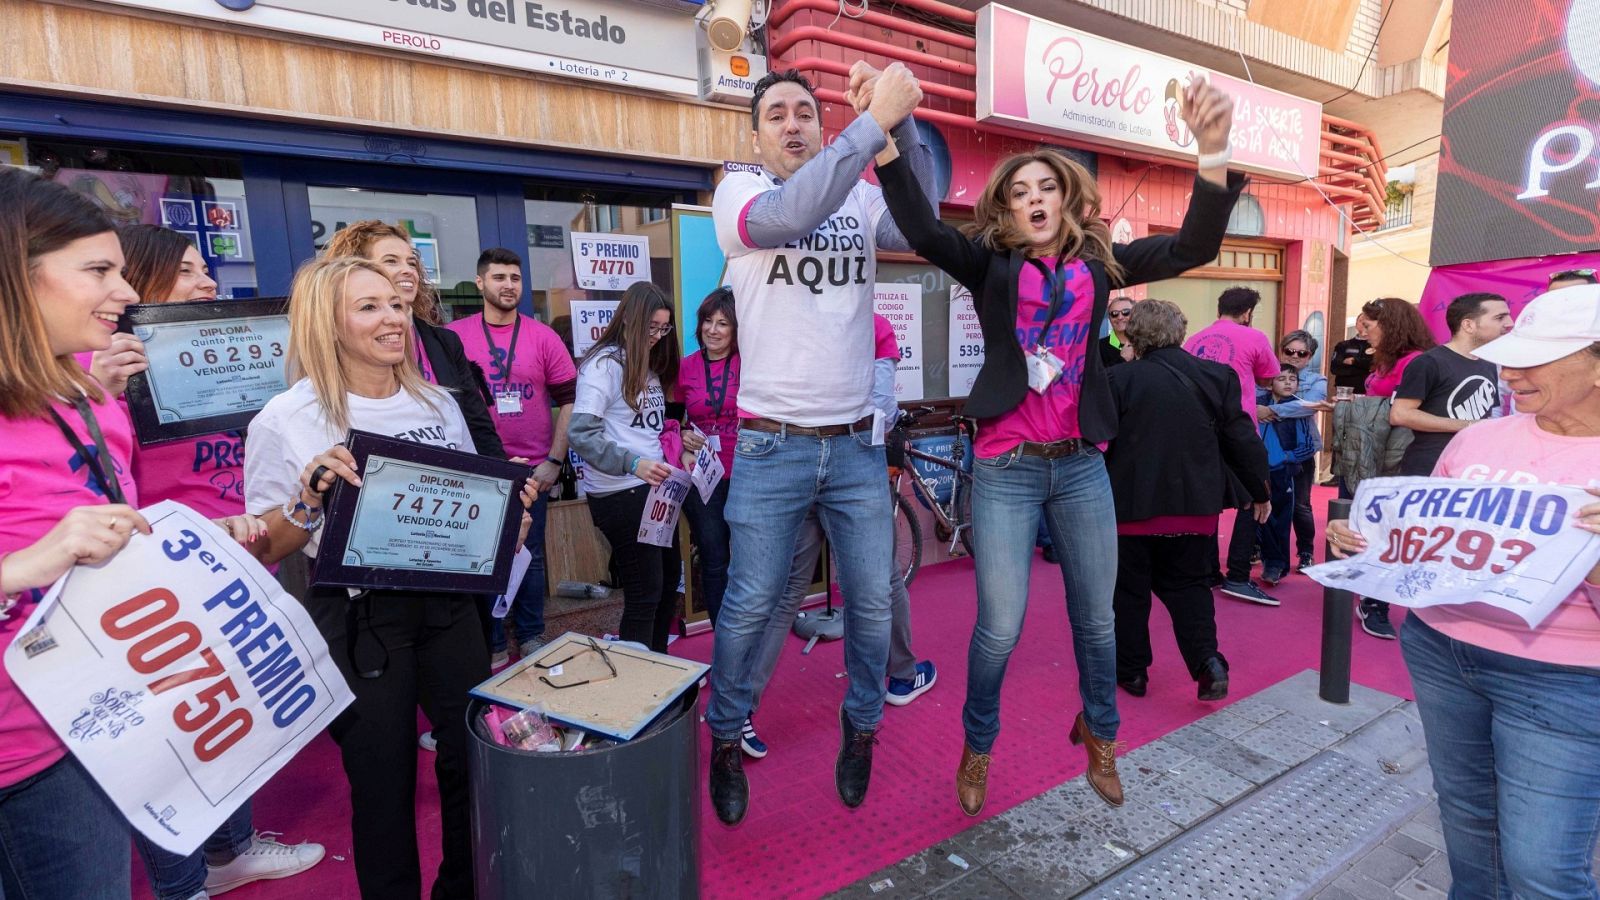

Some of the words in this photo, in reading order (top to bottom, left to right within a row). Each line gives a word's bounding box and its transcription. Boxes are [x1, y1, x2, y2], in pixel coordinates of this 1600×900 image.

[525, 1, 626, 44] Estado
[382, 30, 441, 51] PEROLO
[621, 72, 629, 82] 2
[718, 74, 757, 91] Amstron
[1042, 36, 1154, 115] Perolo
[1235, 95, 1251, 122] LA
[1118, 121, 1128, 132] de
[596, 243, 640, 259] PREMIO
[590, 259, 635, 276] 74770
[766, 251, 867, 295] AQUÍ
[905, 313, 914, 321] DE
[199, 325, 252, 338] DIPLOMA
[191, 337, 226, 347] Quinto
[228, 334, 263, 345] Premio
[193, 363, 246, 377] VENDIDO
[248, 359, 276, 371] AQUÍ
[420, 474, 465, 489] DIPLOMA
[408, 483, 439, 495] Quinto
[441, 487, 471, 500] Premio
[1398, 486, 1569, 536] PREMIO
[397, 514, 443, 528] VENDIDO
[444, 521, 469, 530] AQUÍ
[1378, 525, 1537, 575] 06293
[162, 529, 227, 575] 3er
[203, 578, 318, 730] PREMIO
[100, 587, 255, 763] 00750
